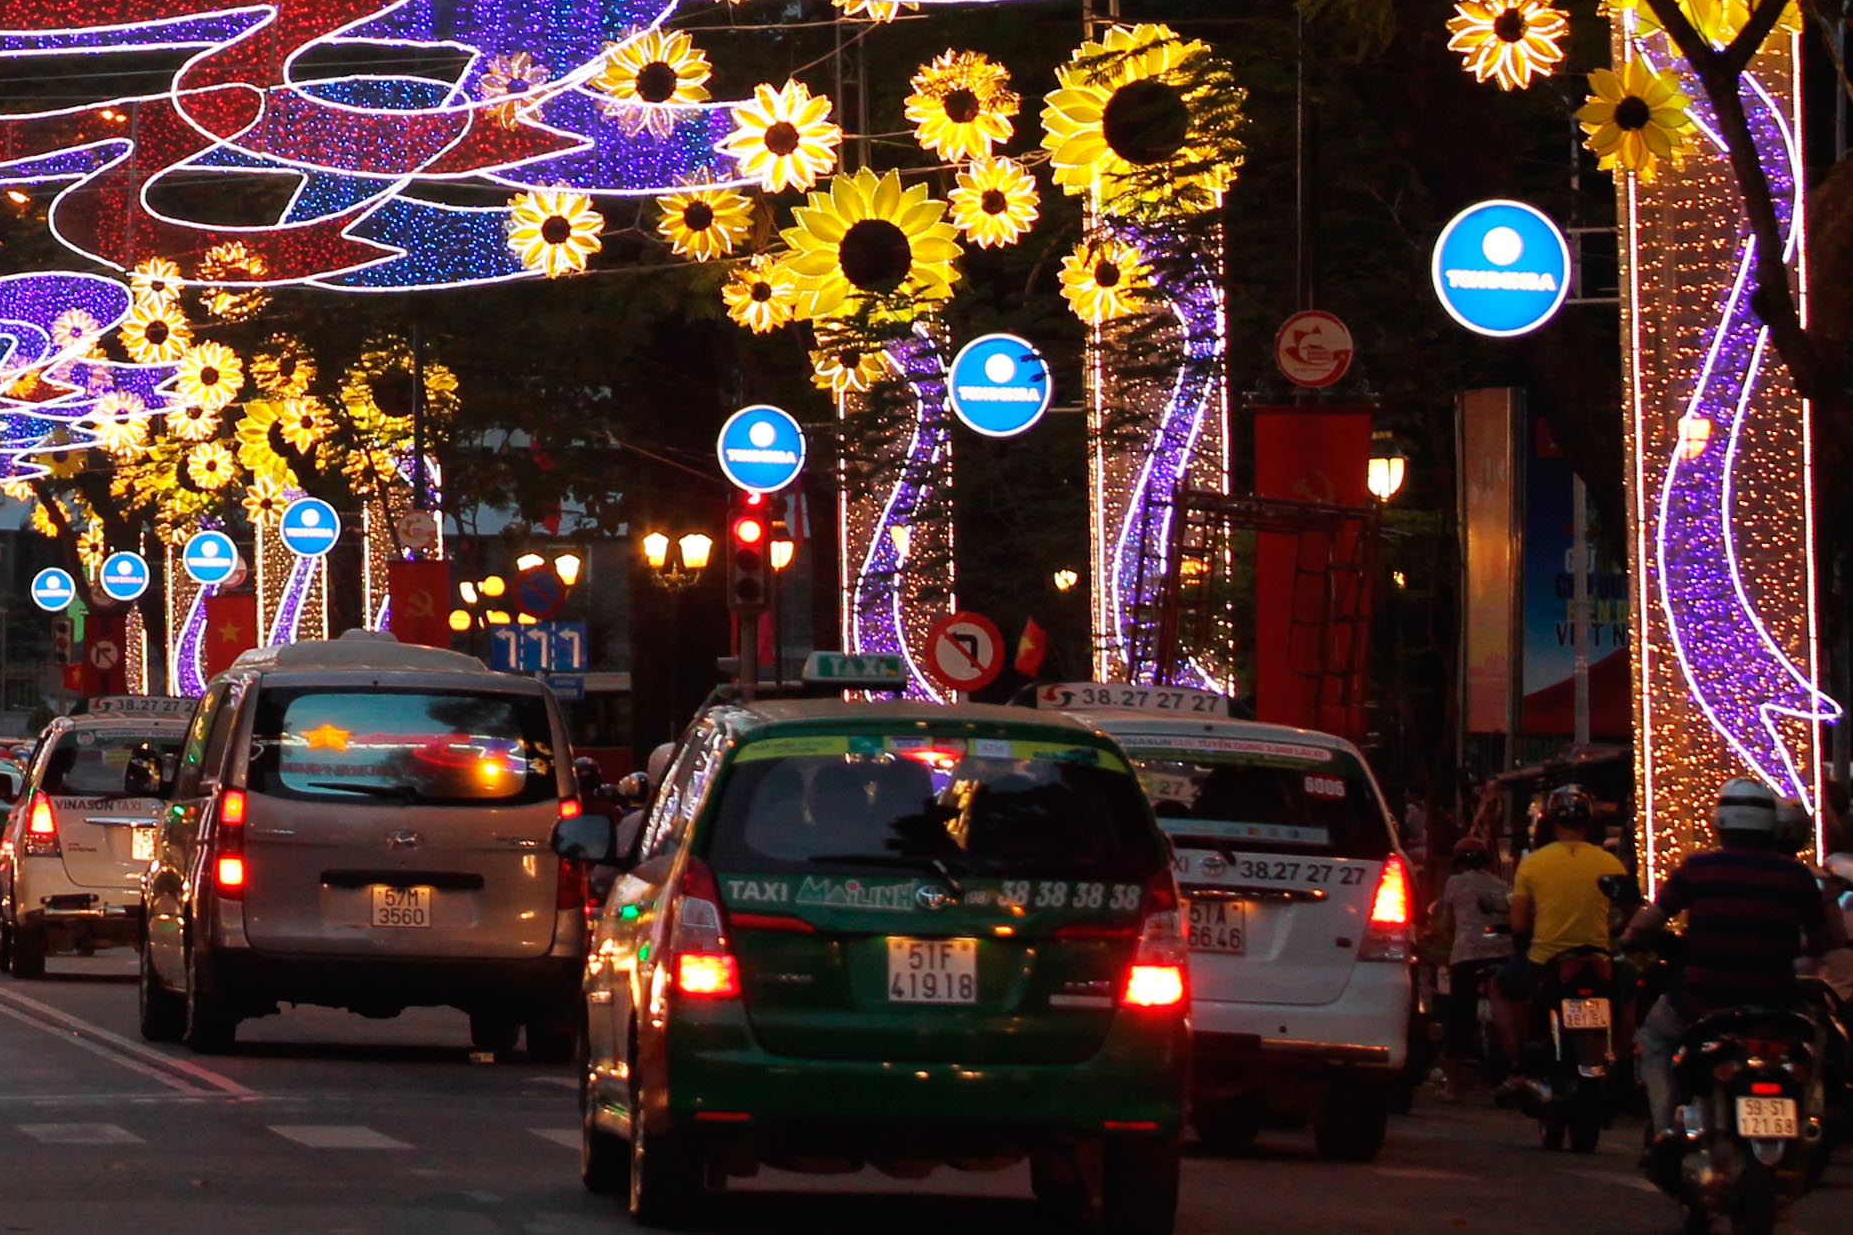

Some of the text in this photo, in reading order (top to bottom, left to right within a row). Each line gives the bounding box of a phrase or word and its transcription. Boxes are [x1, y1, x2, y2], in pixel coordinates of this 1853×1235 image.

[1556, 623, 1602, 646] VIT
[117, 699, 157, 711] 38.27
[164, 700, 180, 711] 27
[1083, 687, 1219, 712] 38.27 27 27
[54, 799, 142, 812] VINASUN TAXI
[1241, 860, 1300, 881] 38.27
[1306, 864, 1332, 883] 27
[1339, 867, 1365, 886] 27
[385, 890, 418, 906] 57M
[728, 879, 788, 902] TAXI
[996, 878, 1029, 907] 38
[1034, 881, 1065, 908] 38
[1072, 882, 1103, 909] 38
[1109, 883, 1141, 911] 38
[379, 907, 424, 924] 3560
[908, 940, 952, 969] 51F
[889, 971, 973, 1000] 419.18
